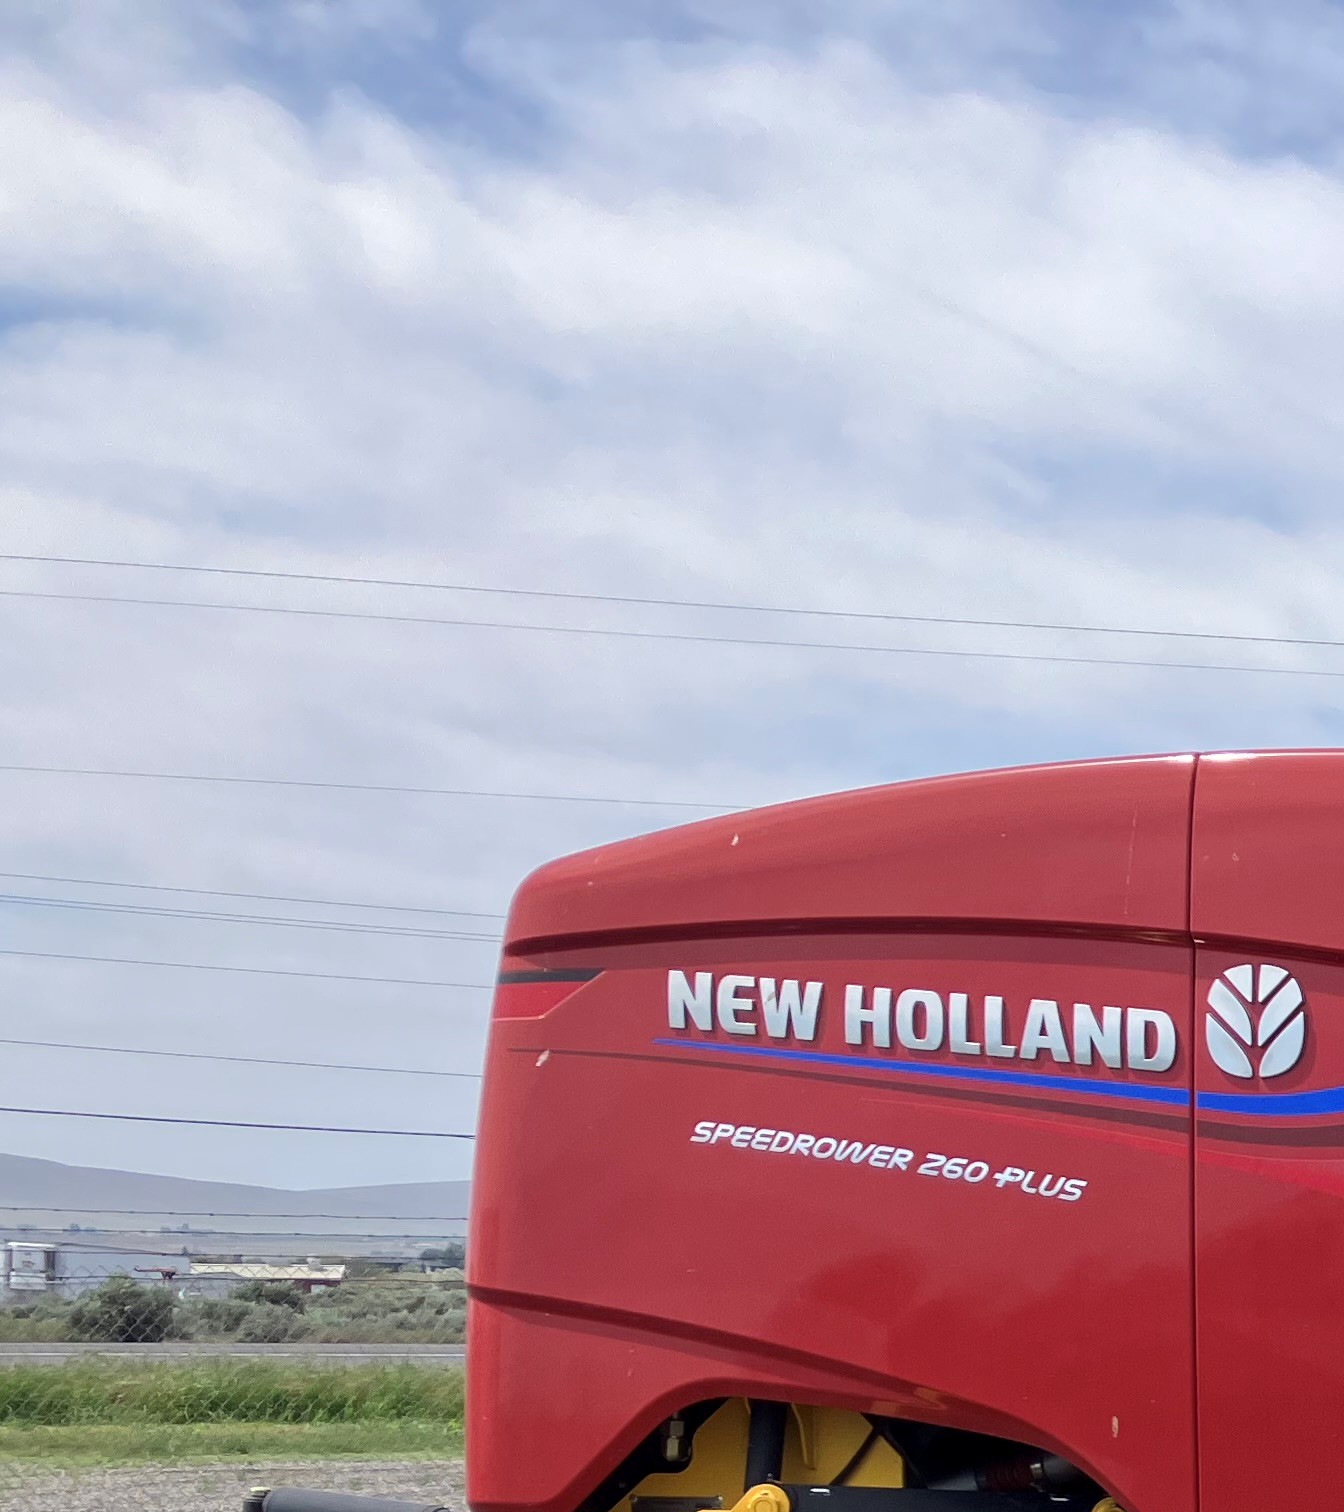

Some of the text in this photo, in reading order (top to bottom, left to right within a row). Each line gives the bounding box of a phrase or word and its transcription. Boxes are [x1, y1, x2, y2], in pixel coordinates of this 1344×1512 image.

[666, 970, 1177, 1073] NEW HOLLAND
[690, 1121, 1087, 1203] SPEEDROWER 260 PLUS
